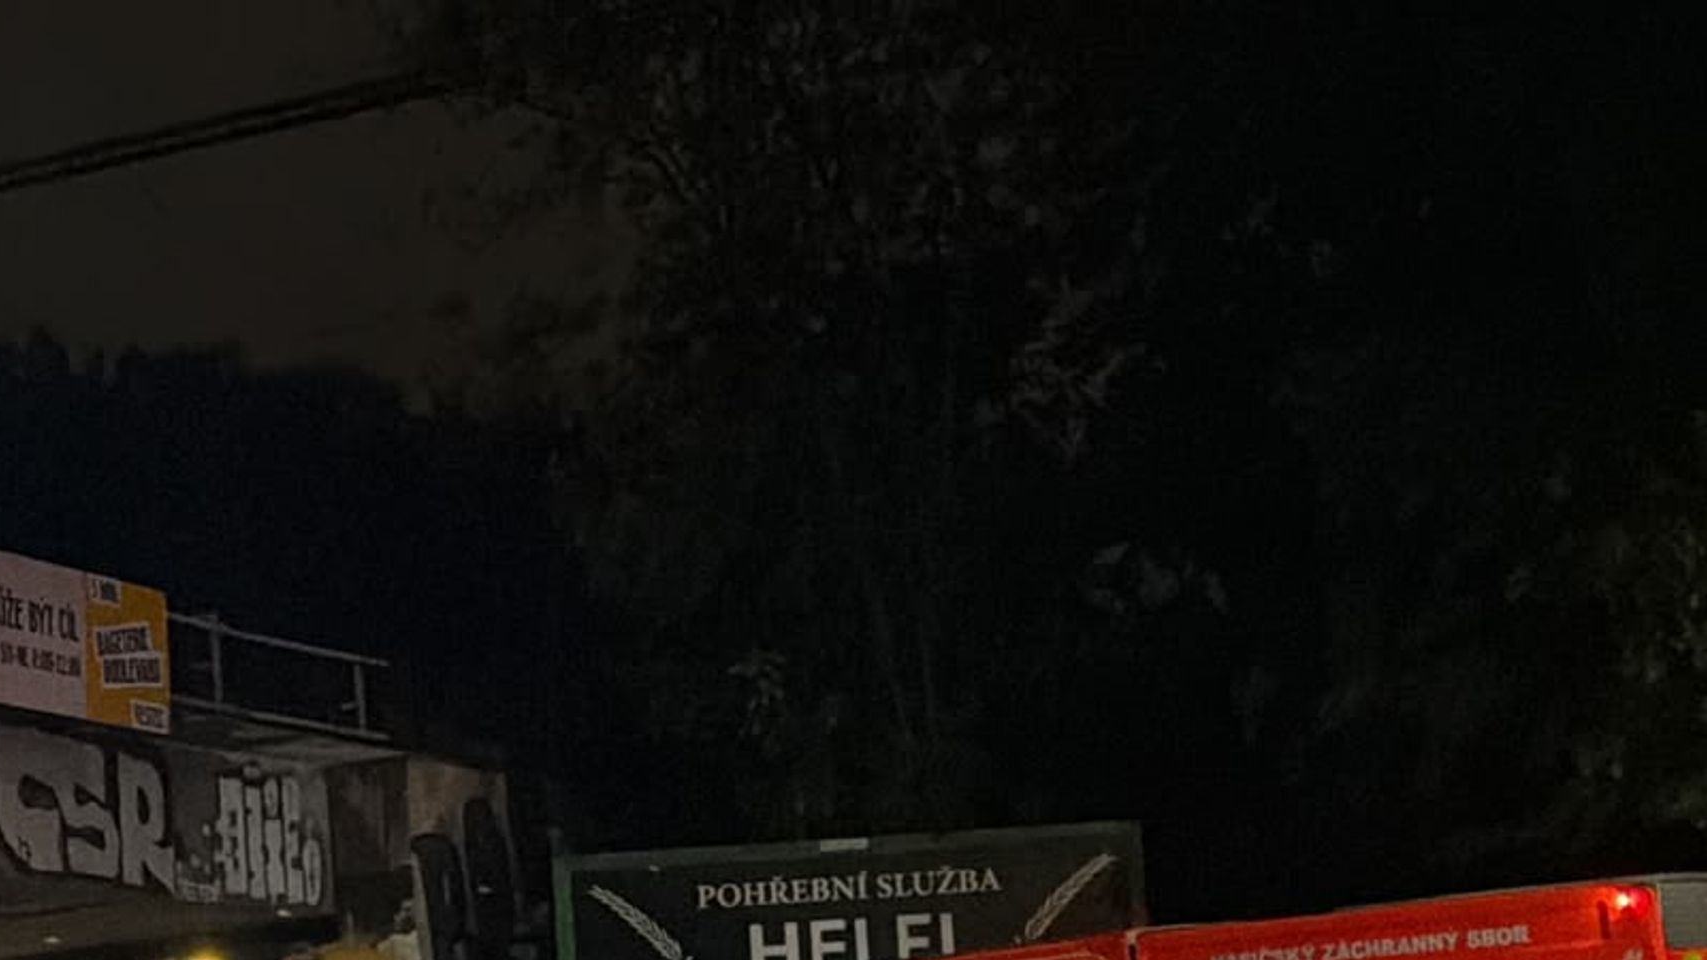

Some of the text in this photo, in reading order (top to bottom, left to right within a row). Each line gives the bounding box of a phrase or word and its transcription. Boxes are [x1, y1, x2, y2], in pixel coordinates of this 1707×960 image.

[697, 865, 1002, 909] POHŘEBNÍ SLUŽBA
[1466, 924, 1532, 950] SBOR
